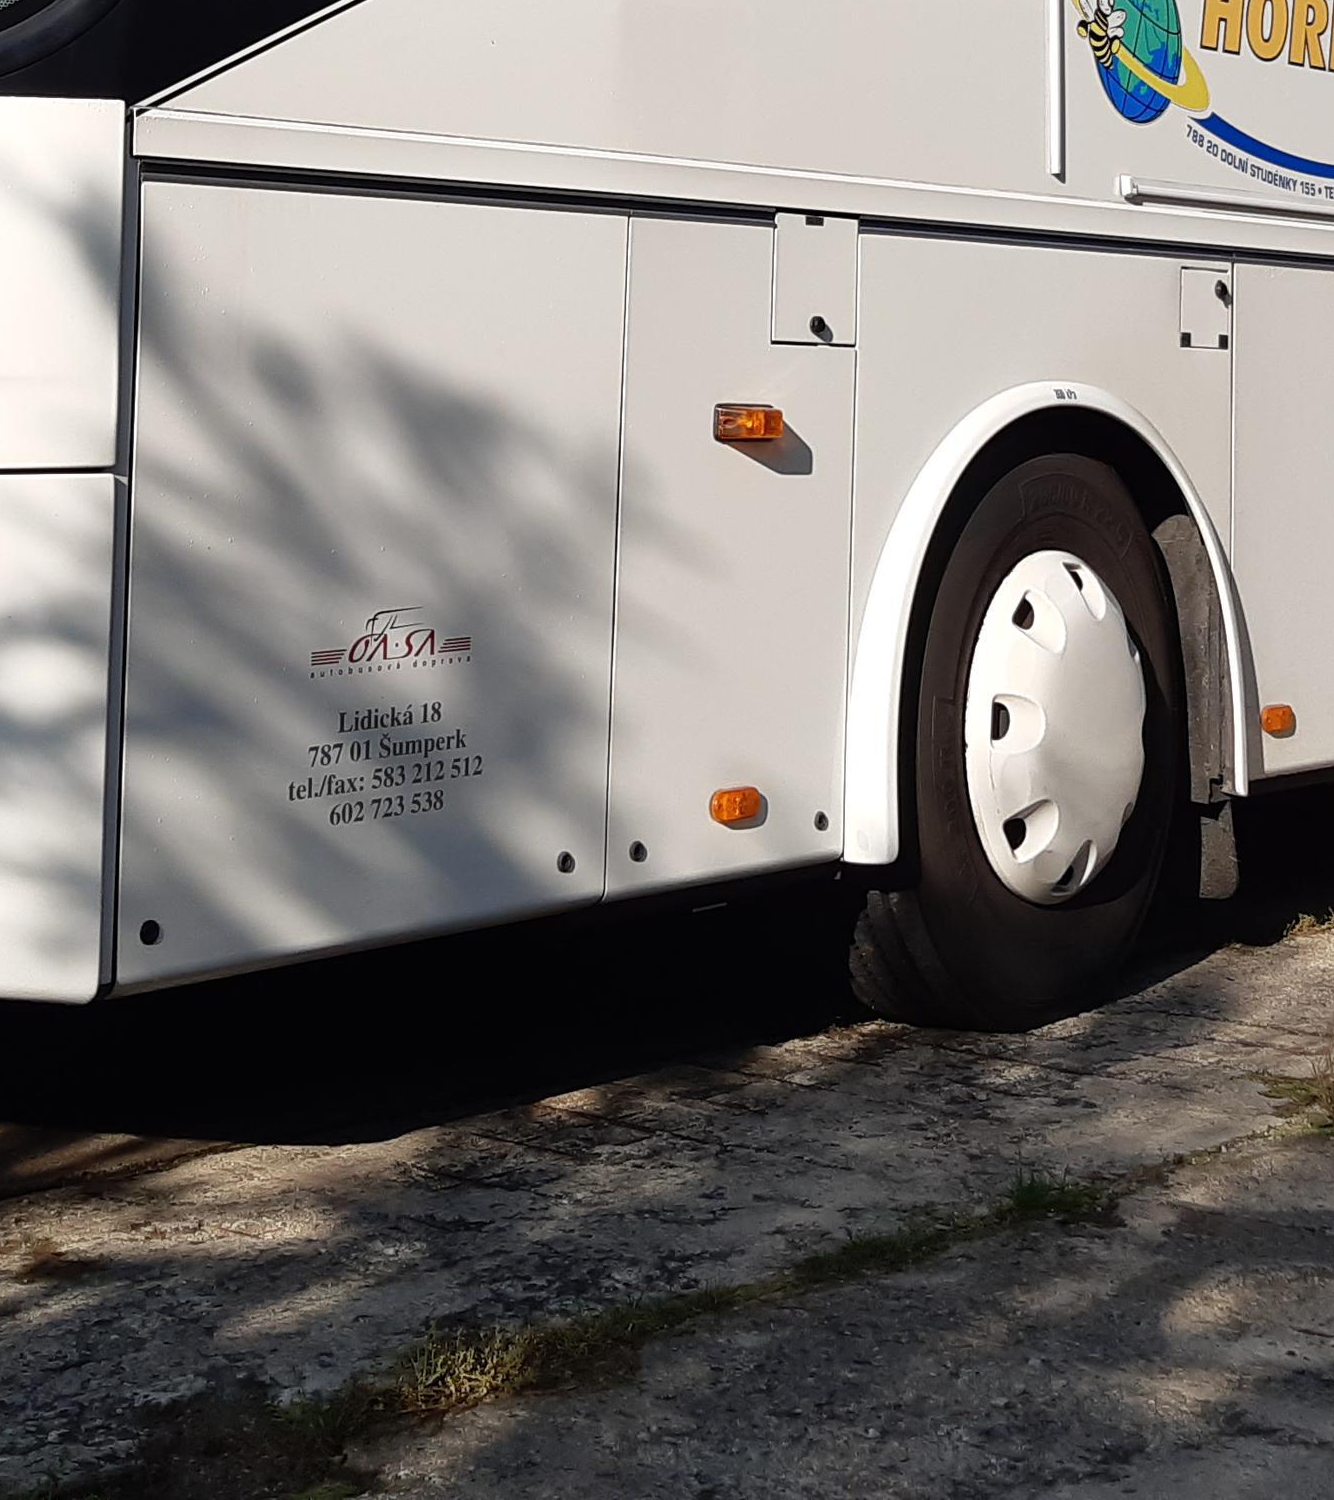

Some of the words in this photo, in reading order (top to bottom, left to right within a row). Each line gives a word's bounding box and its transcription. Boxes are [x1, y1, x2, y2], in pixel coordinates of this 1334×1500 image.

[1186, 124, 1204, 148] 788
[1206, 140, 1218, 157] 20
[1220, 150, 1249, 174] DOLNÍ
[1250, 165, 1298, 192] STUDÉNKY
[1300, 182, 1316, 196] 155
[310, 661, 401, 679] autobusová
[412, 655, 471, 669] doprava
[338, 704, 413, 733] Lidická
[420, 702, 442, 723] 18
[308, 743, 343, 768] 787
[350, 740, 372, 762] 01
[378, 729, 467, 758] Šumperk
[288, 775, 365, 801] tel./fax:
[371, 765, 405, 789] 583
[412, 760, 444, 784] 212
[451, 755, 483, 779] 512
[329, 801, 364, 826] 602
[370, 795, 405, 819] 723
[411, 790, 444, 814] 538
